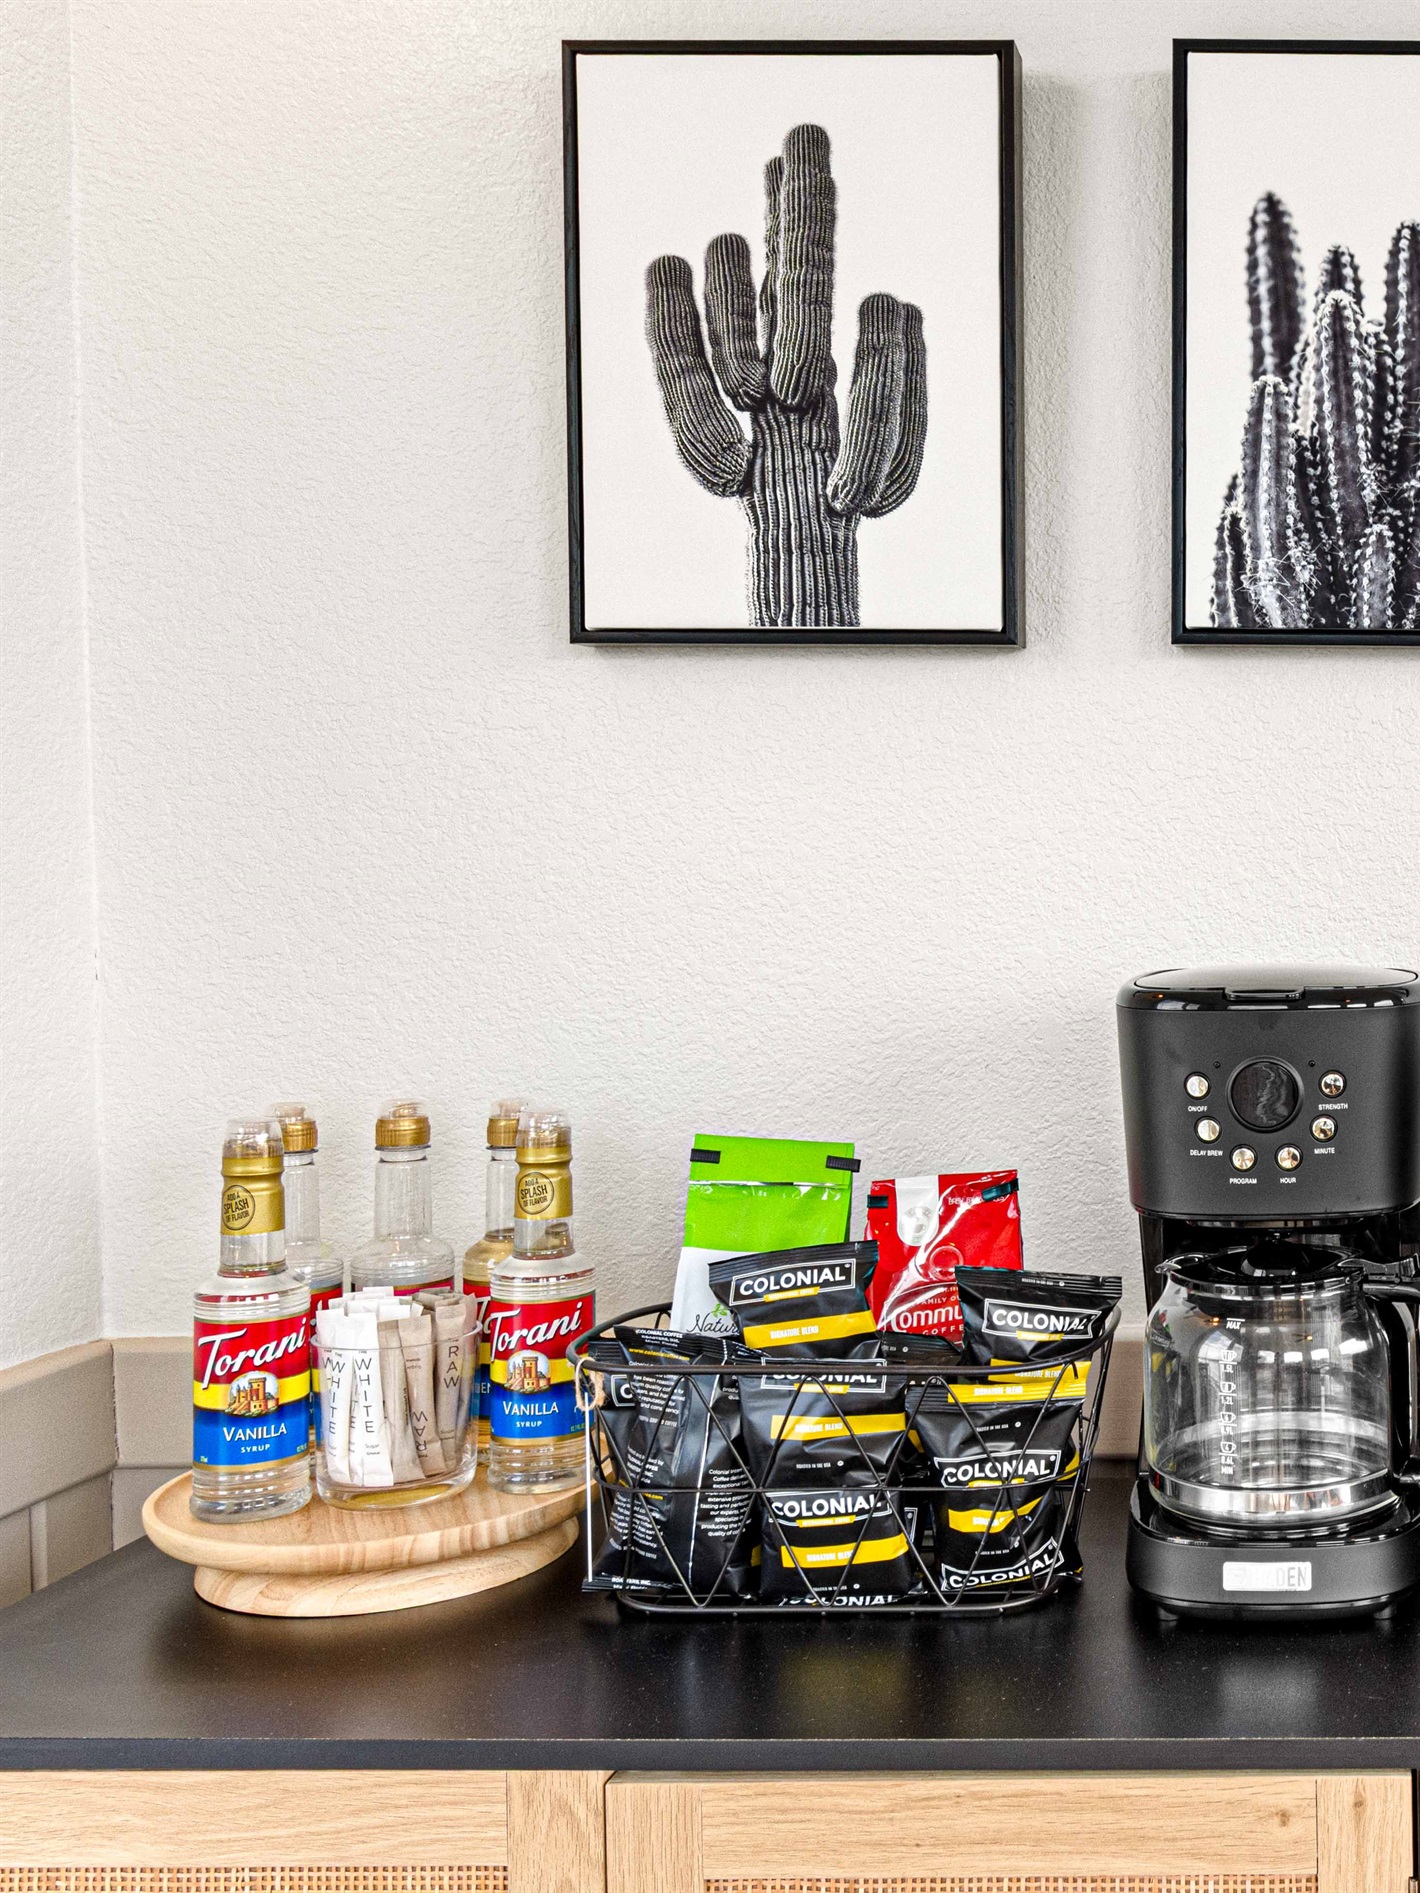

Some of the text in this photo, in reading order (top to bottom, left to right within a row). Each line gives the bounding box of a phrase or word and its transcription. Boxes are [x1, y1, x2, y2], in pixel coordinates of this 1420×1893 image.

[1318, 1103, 1348, 1111] STRENGTH
[1314, 1147, 1335, 1155] MINUTE
[520, 1184, 548, 1200] SPLASH
[223, 1198, 249, 1215] SPLASH
[529, 1196, 548, 1206] FLAVOR
[225, 1210, 250, 1222] OF FLAVOR
[739, 1266, 846, 1296] COLONIAL
[686, 1312, 739, 1334] Natur
[992, 1308, 1087, 1331] COLONIAL
[1226, 1320, 1242, 1330] MAX
[490, 1301, 583, 1363] Torani
[770, 1325, 819, 1340] SIGNATURE BLEND
[922, 1324, 964, 1335] COFFE
[197, 1317, 307, 1390] Torani
[443, 1345, 460, 1389] RAW
[328, 1359, 346, 1435] WHITE
[355, 1357, 375, 1433] WHITE
[974, 1385, 1024, 1395] SIGNATURE BLEND
[502, 1401, 559, 1416] VANILLA
[515, 1420, 543, 1428] SYRUP
[824, 1422, 843, 1431] BLEND
[222, 1422, 288, 1442] VANILLA
[240, 1443, 271, 1454] SYRUP
[943, 1459, 1050, 1482] COLONIAL
[1221, 1466, 1234, 1475] MIN
[771, 1493, 882, 1518] COLONIAL
[806, 1549, 854, 1562] SIGNATURE BLEN
[949, 1552, 1055, 1588] COLONIAL
